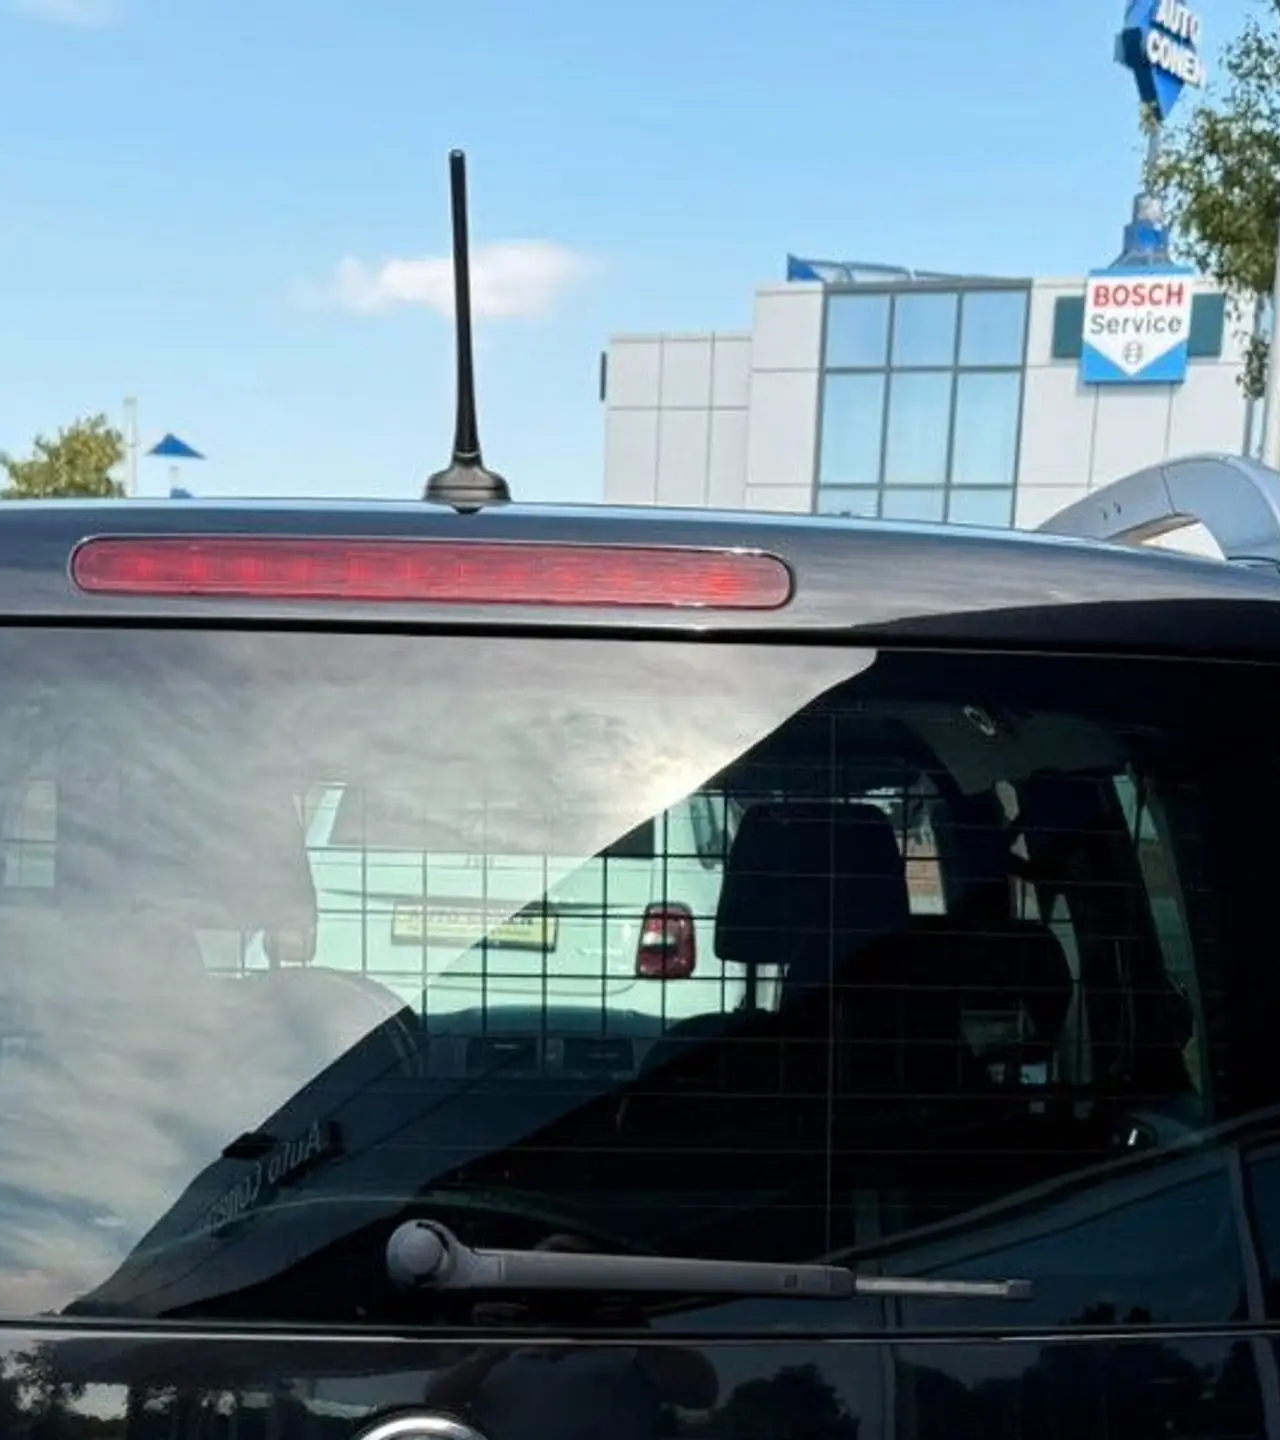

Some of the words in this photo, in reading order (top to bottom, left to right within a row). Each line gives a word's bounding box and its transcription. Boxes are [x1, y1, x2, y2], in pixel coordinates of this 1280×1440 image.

[1154, 0, 1200, 40] AUTO
[1093, 283, 1184, 308] BOSCH
[1090, 311, 1182, 335] Service
